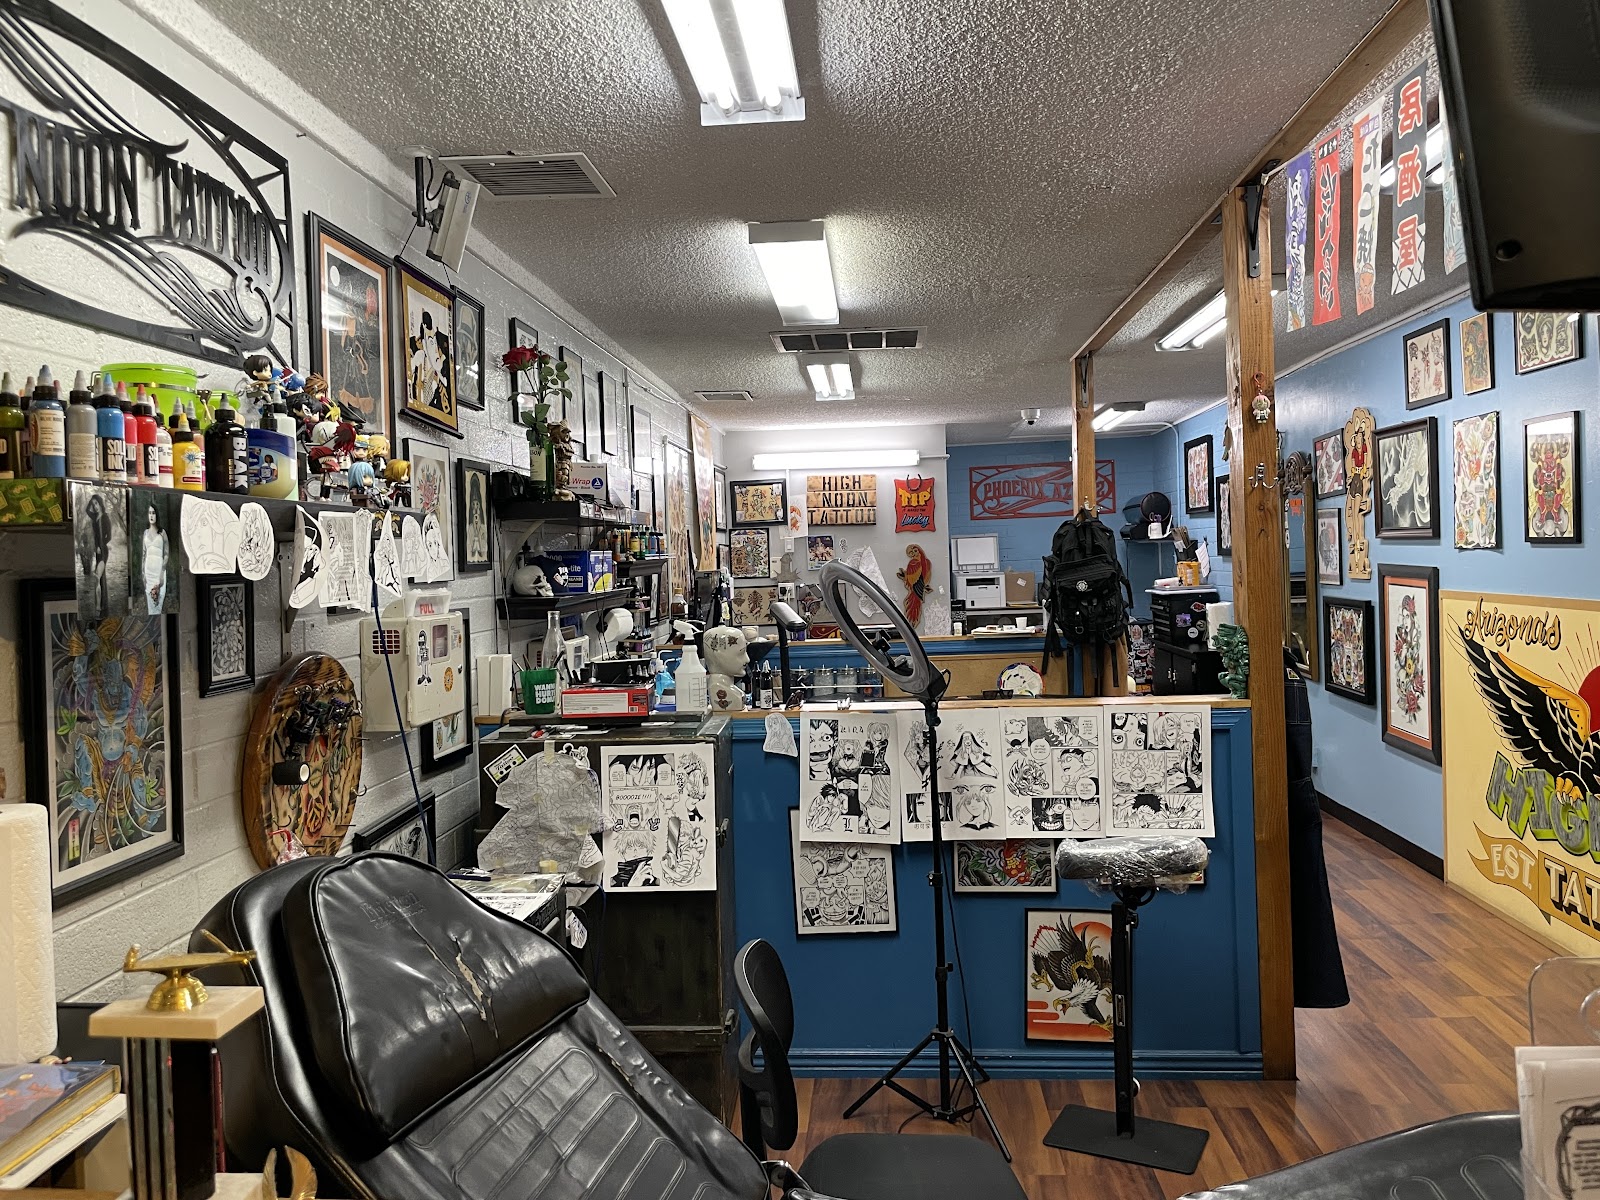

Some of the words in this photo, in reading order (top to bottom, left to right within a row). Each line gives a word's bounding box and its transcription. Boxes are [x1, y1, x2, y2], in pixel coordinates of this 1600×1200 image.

[107, 438, 126, 455] SOLI
[108, 455, 124, 470] INK
[572, 477, 591, 486] Wrap
[822, 475, 862, 491] HIGH
[984, 479, 1045, 500] PHOENIX
[822, 491, 869, 508] NOON
[898, 487, 932, 507] TIP
[807, 508, 876, 525] TATTOO
[901, 513, 930, 529] Lucky
[420, 603, 435, 614] FULL
[1463, 596, 1562, 652] Arizona's
[1490, 843, 1537, 891] EST.
[1544, 857, 1600, 931] TAT
